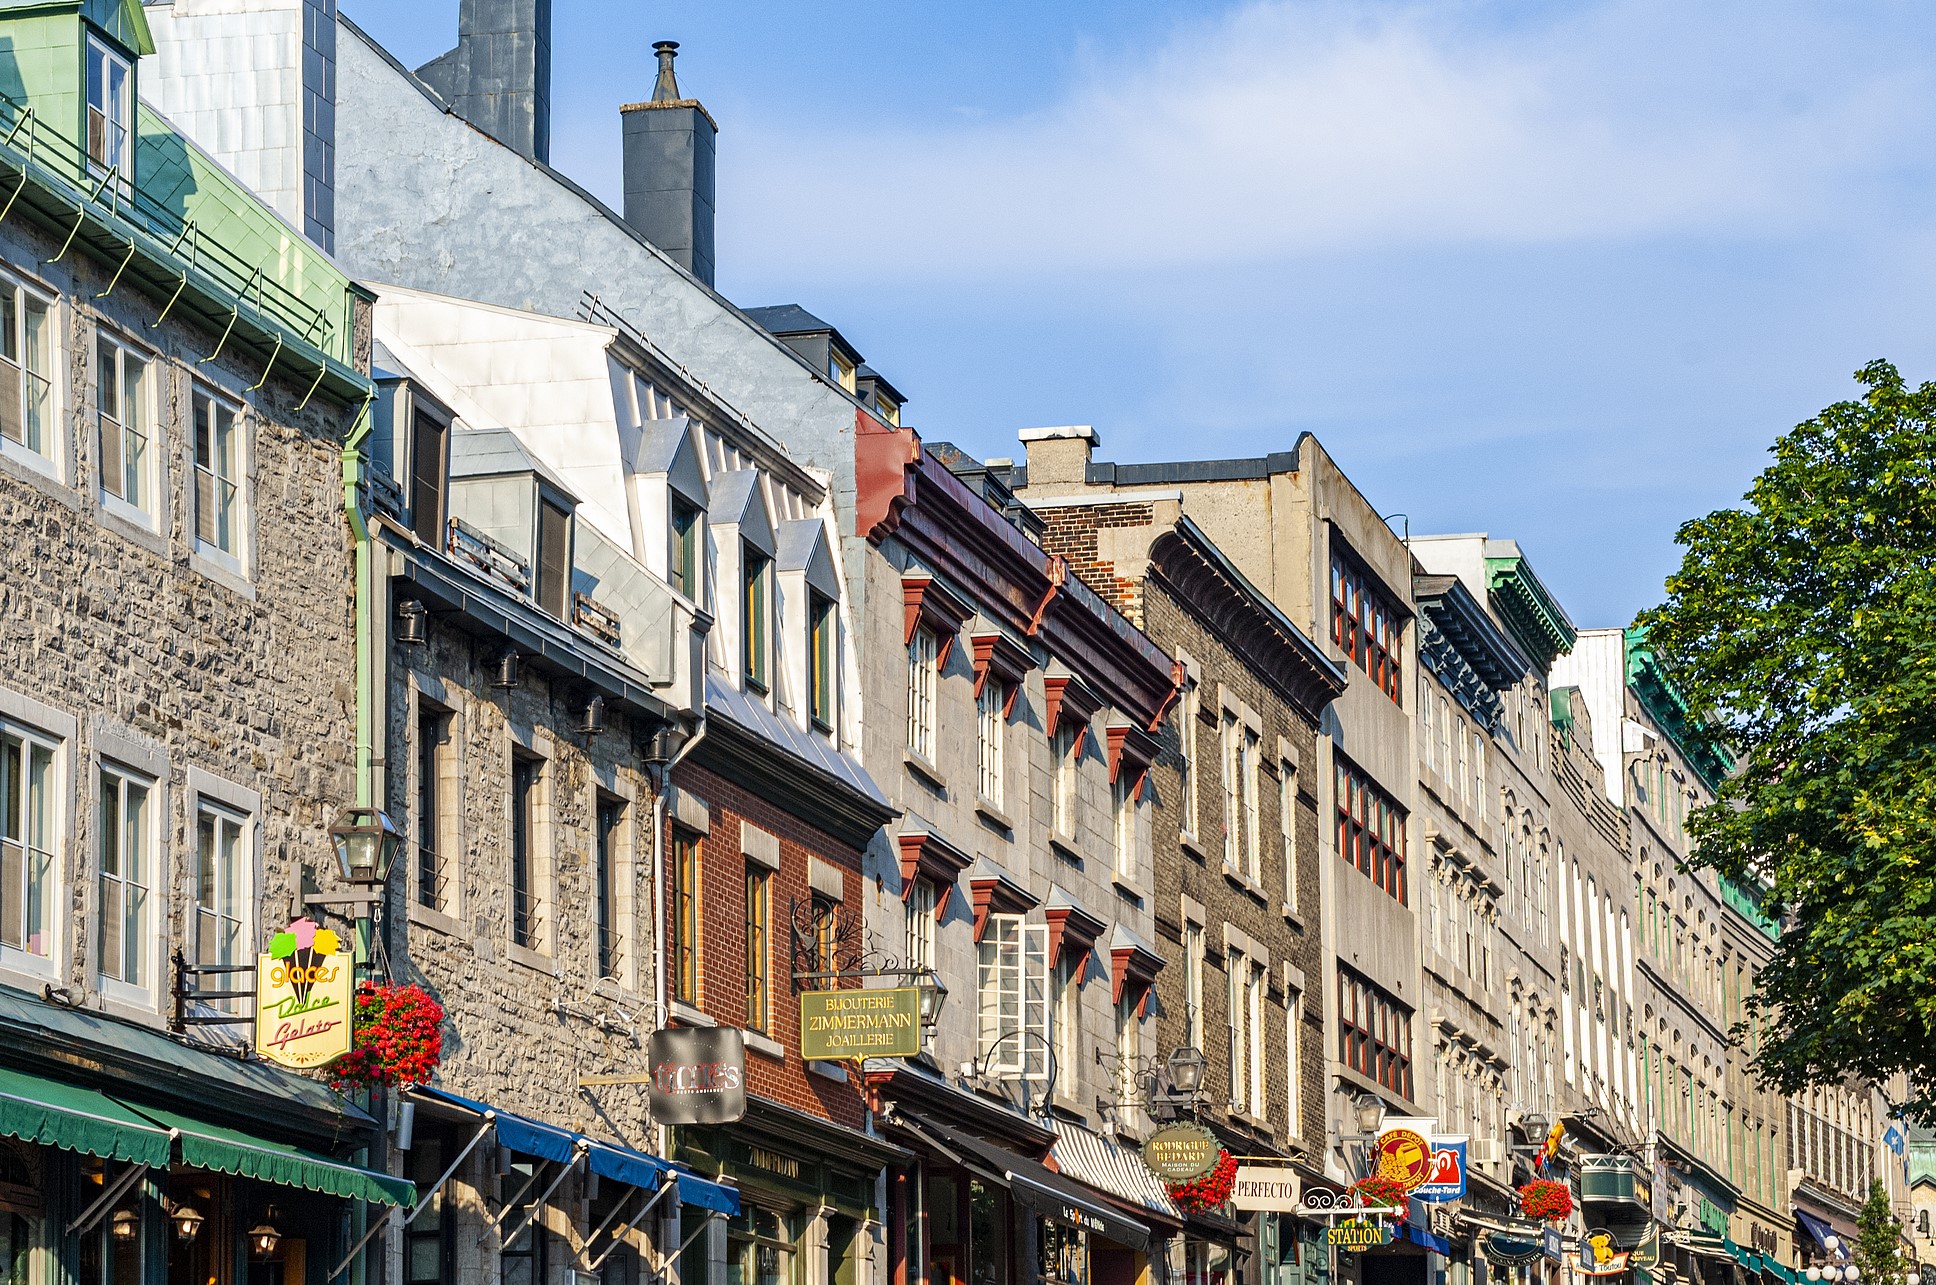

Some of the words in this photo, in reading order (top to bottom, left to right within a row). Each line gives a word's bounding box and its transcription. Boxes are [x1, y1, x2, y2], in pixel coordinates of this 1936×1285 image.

[271, 961, 339, 988] glaces
[267, 991, 336, 1018] Dolce
[825, 997, 894, 1011] BIJOUTERIE
[809, 1013, 911, 1031] ZIMMERMANN
[269, 1018, 338, 1050] Gelato
[826, 1033, 894, 1048] JOAILLERIE
[1152, 1141, 1209, 1151] RODRIGUE
[1238, 1181, 1293, 1198] PERFECTO
[1413, 1186, 1461, 1195] Couche-Tard
[1327, 1227, 1383, 1245] STATION
[1600, 1263, 1622, 1272] Toutou
